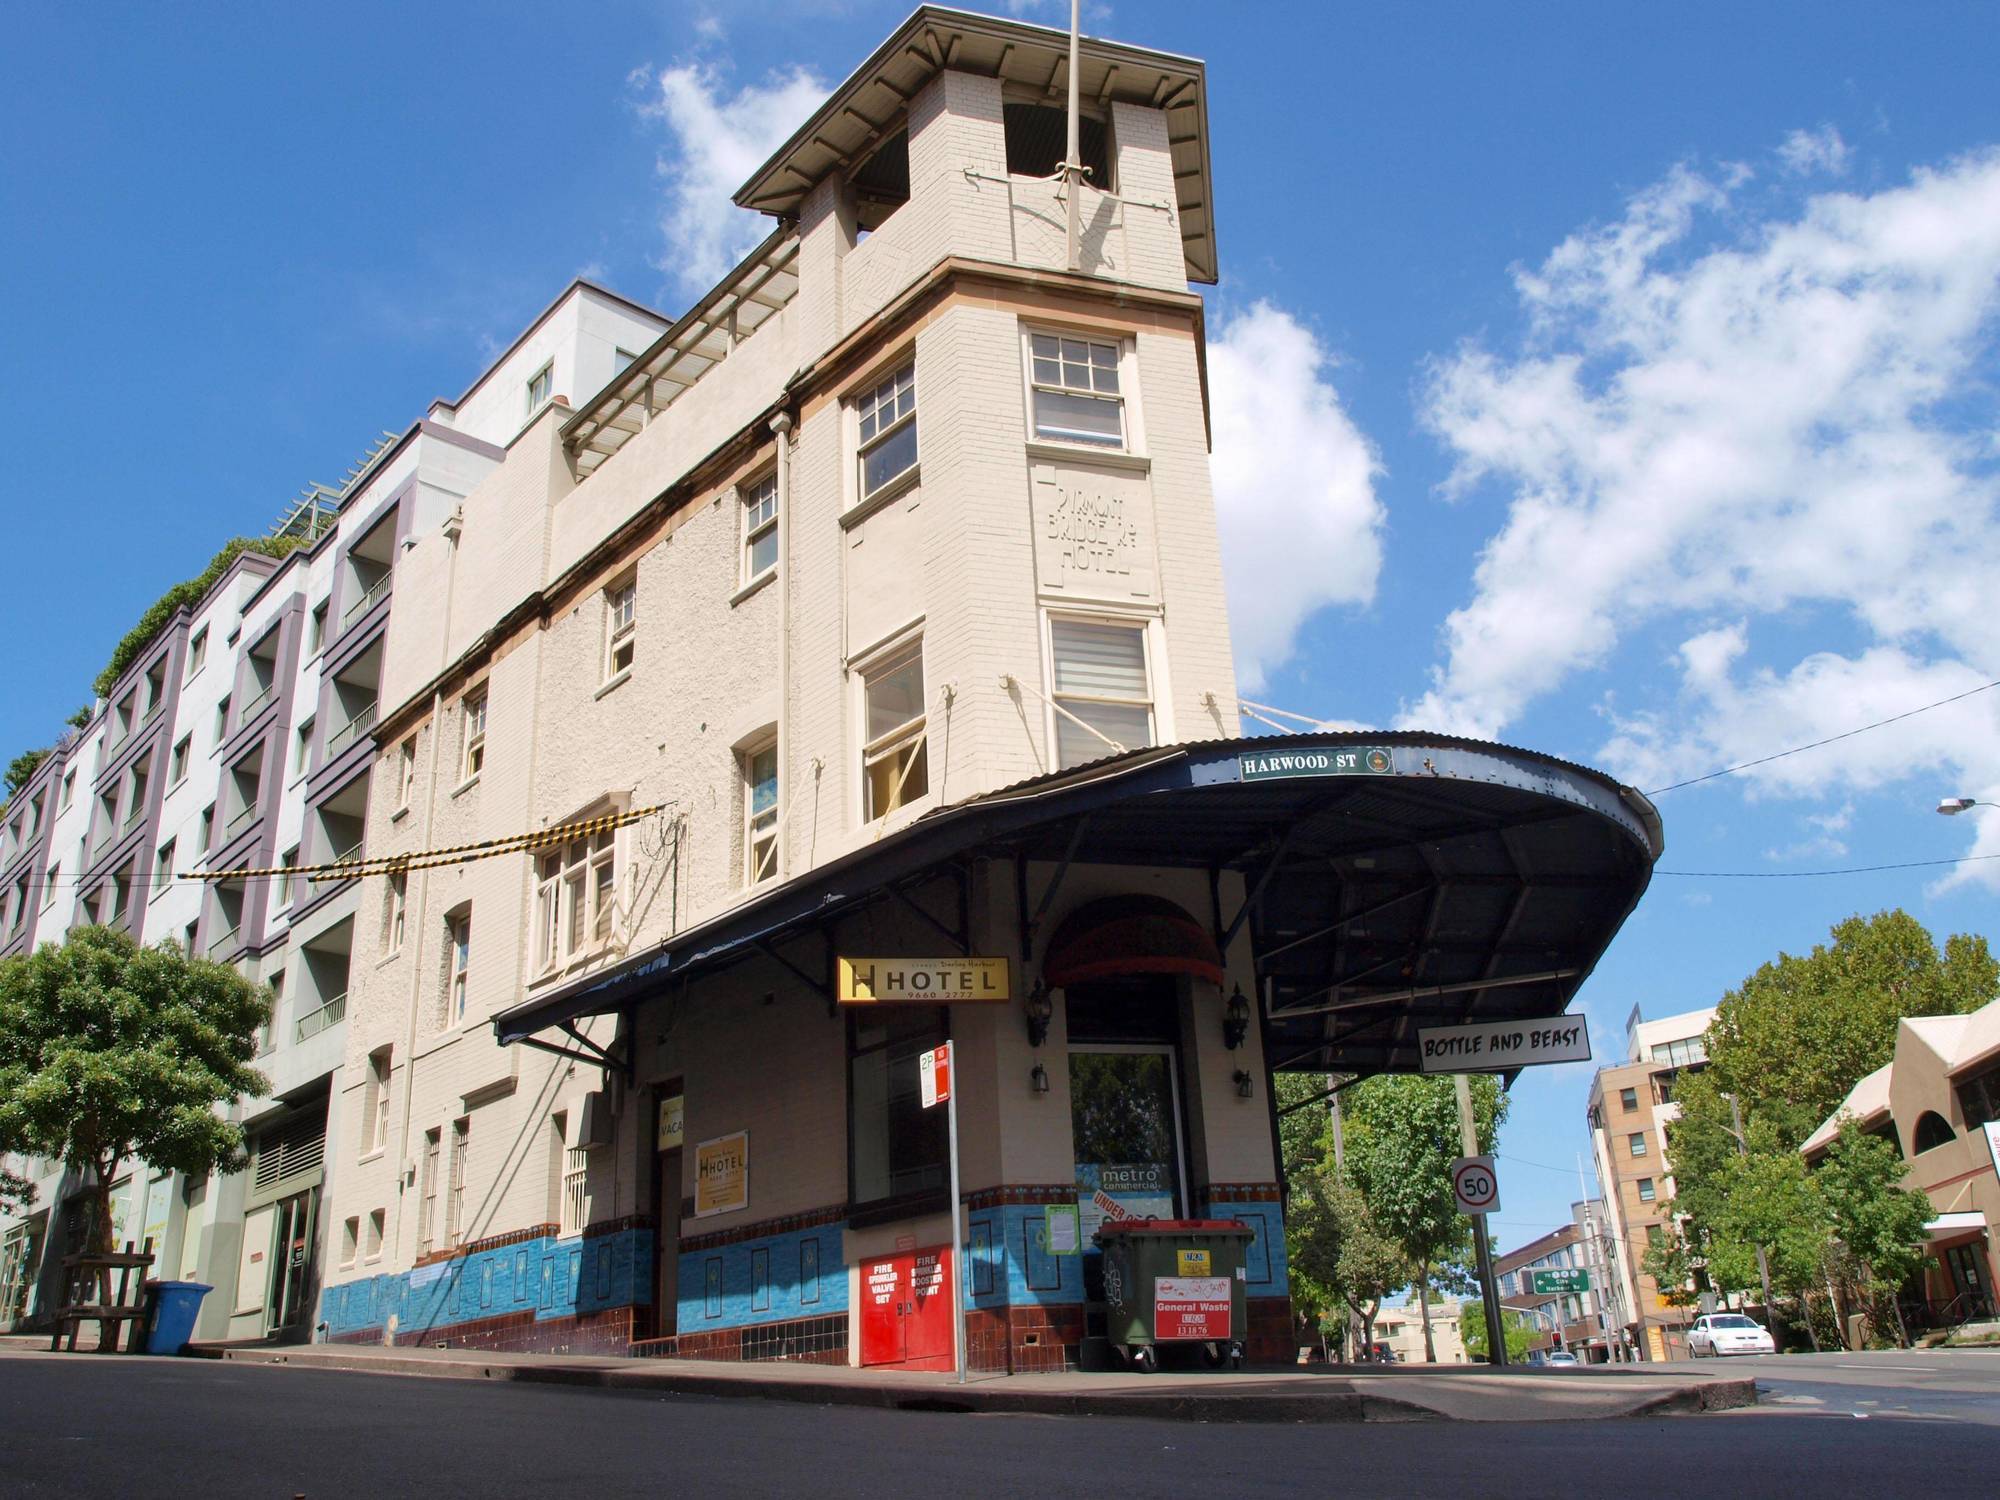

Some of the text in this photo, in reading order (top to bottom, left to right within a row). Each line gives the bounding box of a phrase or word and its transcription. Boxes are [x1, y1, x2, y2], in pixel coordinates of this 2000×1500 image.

[1048, 515, 1108, 544] BRIDGE
[1061, 545, 1130, 575] HOTEL
[1244, 754, 1357, 774] HARWOOD ST
[887, 972, 996, 990] HOTEL
[1424, 1028, 1580, 1057] BOTTLE AND BEAST
[921, 1055, 933, 1070] 2P
[709, 1155, 744, 1174] HOTEL
[1103, 1168, 1157, 1181] metro
[1463, 1177, 1489, 1197] 50
[1094, 1192, 1125, 1220] UNDER
[917, 1256, 936, 1266] FIRE
[874, 1263, 893, 1274] FIRE
[911, 1274, 943, 1287] BOOSTER
[871, 1283, 895, 1294] VALVE
[915, 1285, 939, 1297] POINT
[875, 1294, 890, 1304] SET
[1157, 1302, 1229, 1312] General Waste
[1177, 1327, 1208, 1335] 13 18 76
